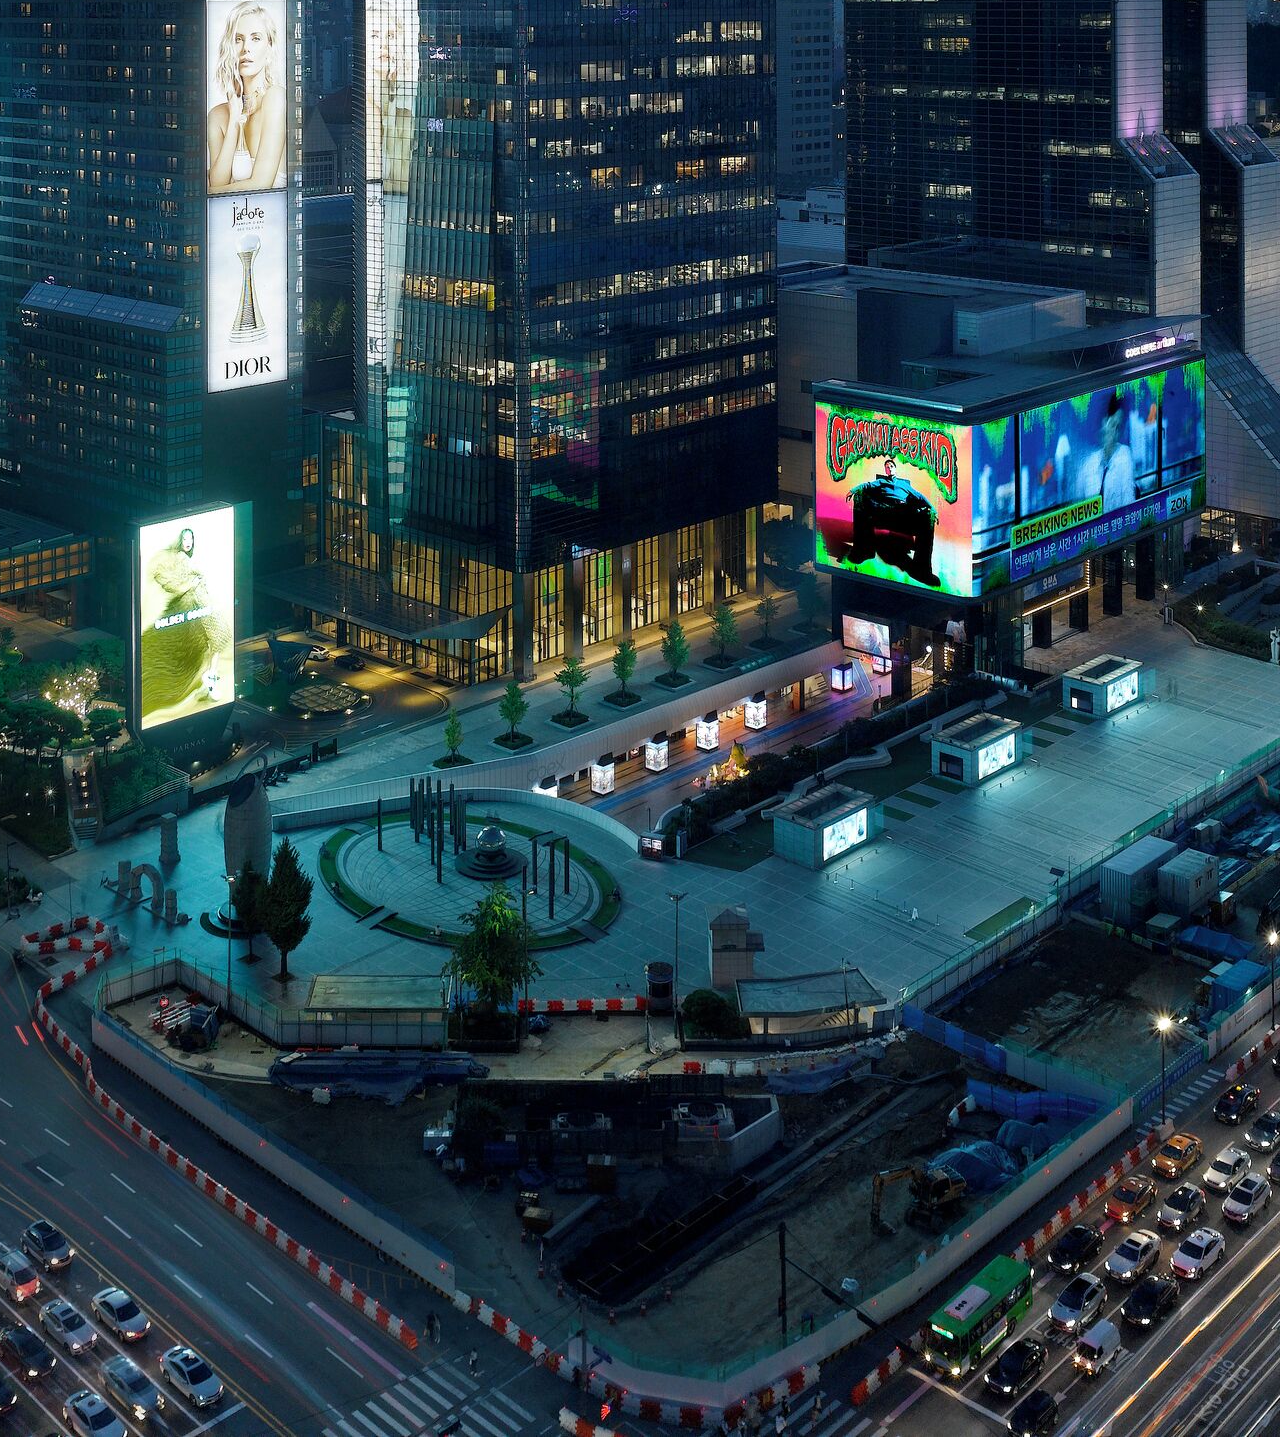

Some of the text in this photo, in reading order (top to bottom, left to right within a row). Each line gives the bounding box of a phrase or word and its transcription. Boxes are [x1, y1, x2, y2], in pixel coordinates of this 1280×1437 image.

[231, 197, 265, 228] j'adore
[224, 355, 272, 380] DIOR
[831, 415, 953, 496] GROWN ASS KID
[1170, 495, 1188, 513] ZOK
[1015, 500, 1099, 545] BREAKING NEWS
[1014, 549, 1042, 570] 인류에게
[1043, 543, 1057, 558] 남은
[1058, 536, 1072, 553] 시간
[1072, 528, 1090, 546] 1시간
[1091, 523, 1110, 540] 내외로
[1124, 508, 1143, 527] 코앞에
[173, 737, 206, 754] PARNAS
